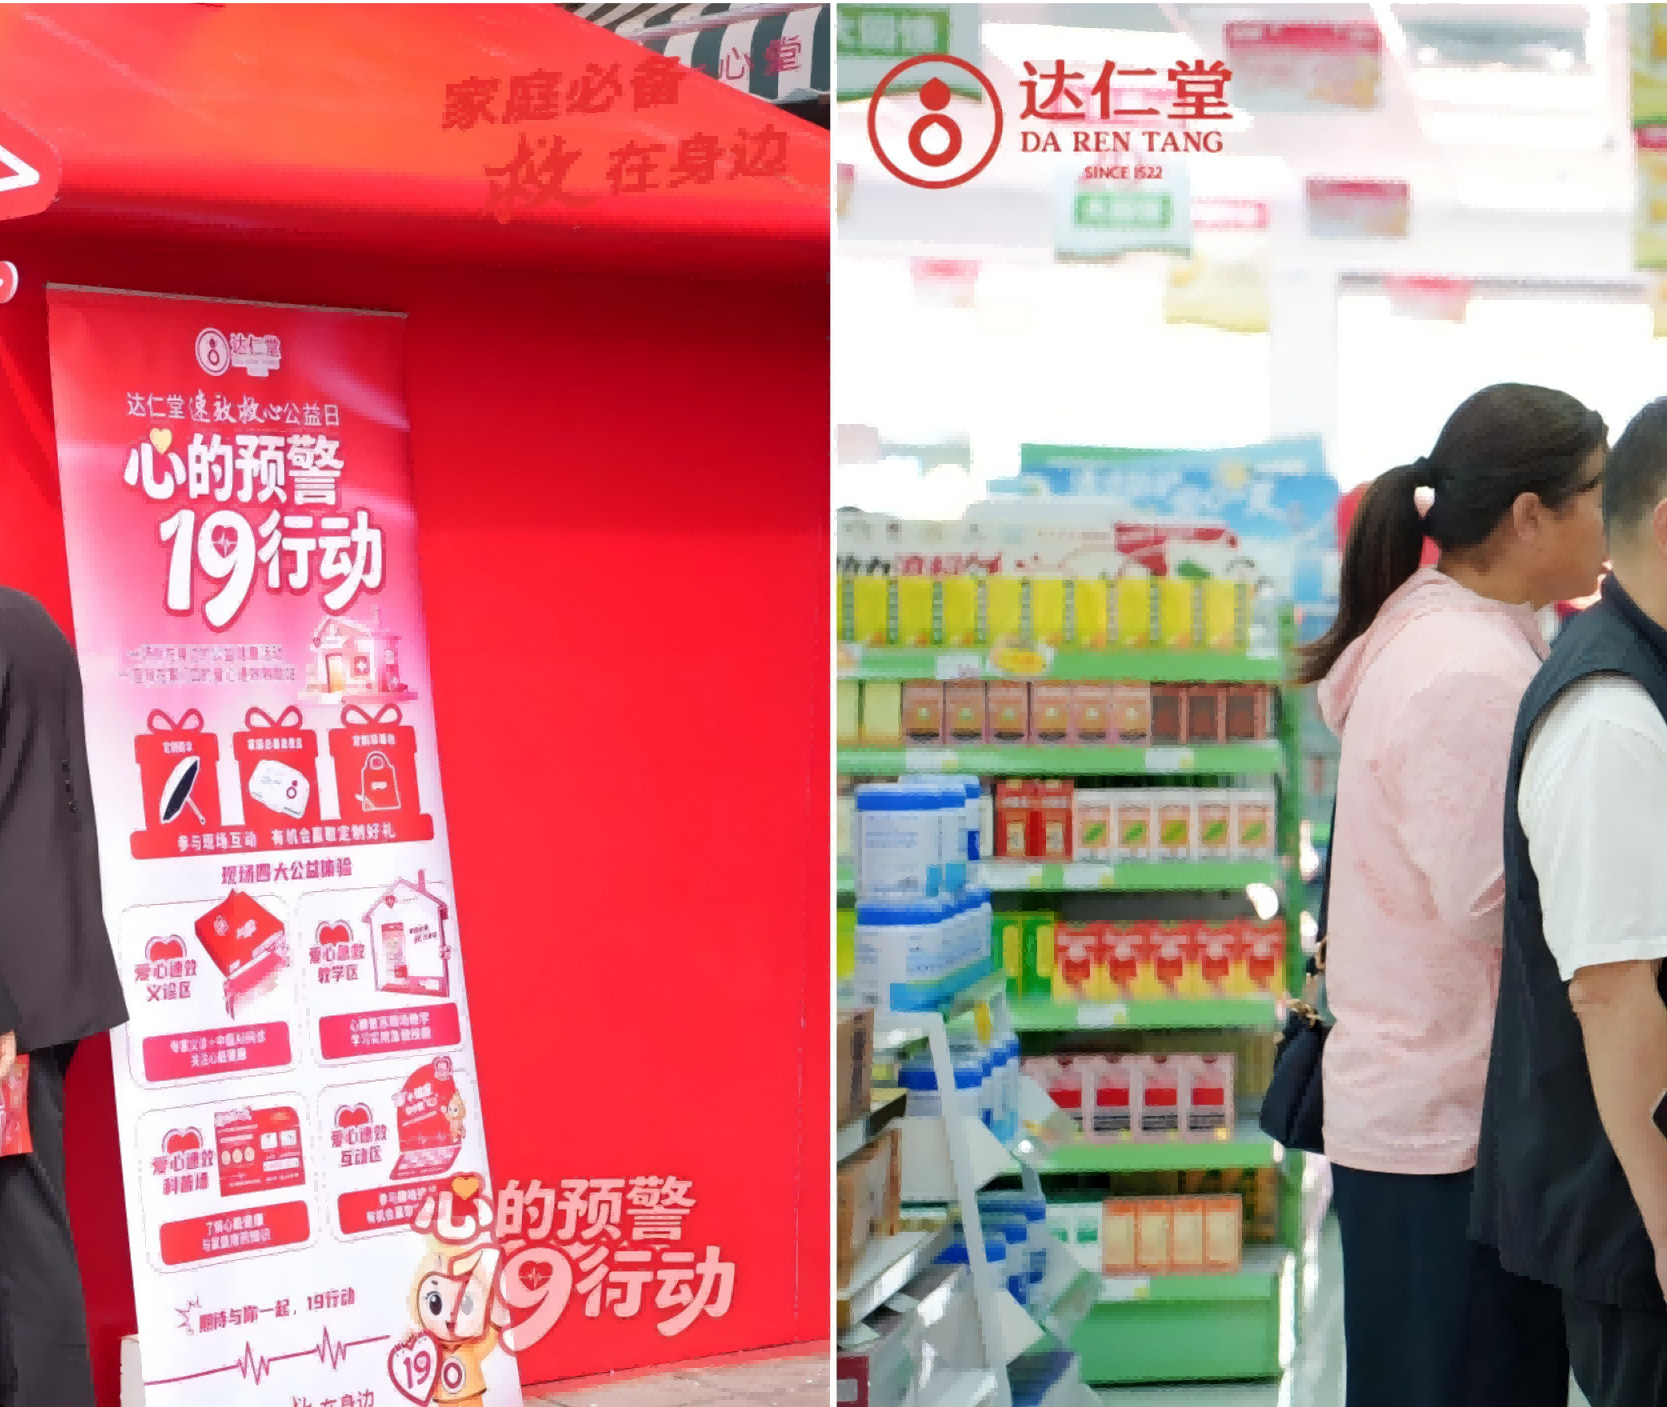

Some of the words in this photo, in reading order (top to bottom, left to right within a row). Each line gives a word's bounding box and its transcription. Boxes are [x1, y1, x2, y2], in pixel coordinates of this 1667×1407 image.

[123, 427, 345, 506] 心的预警
[159, 508, 383, 628] 19行动
[402, 1350, 433, 1390] 19
